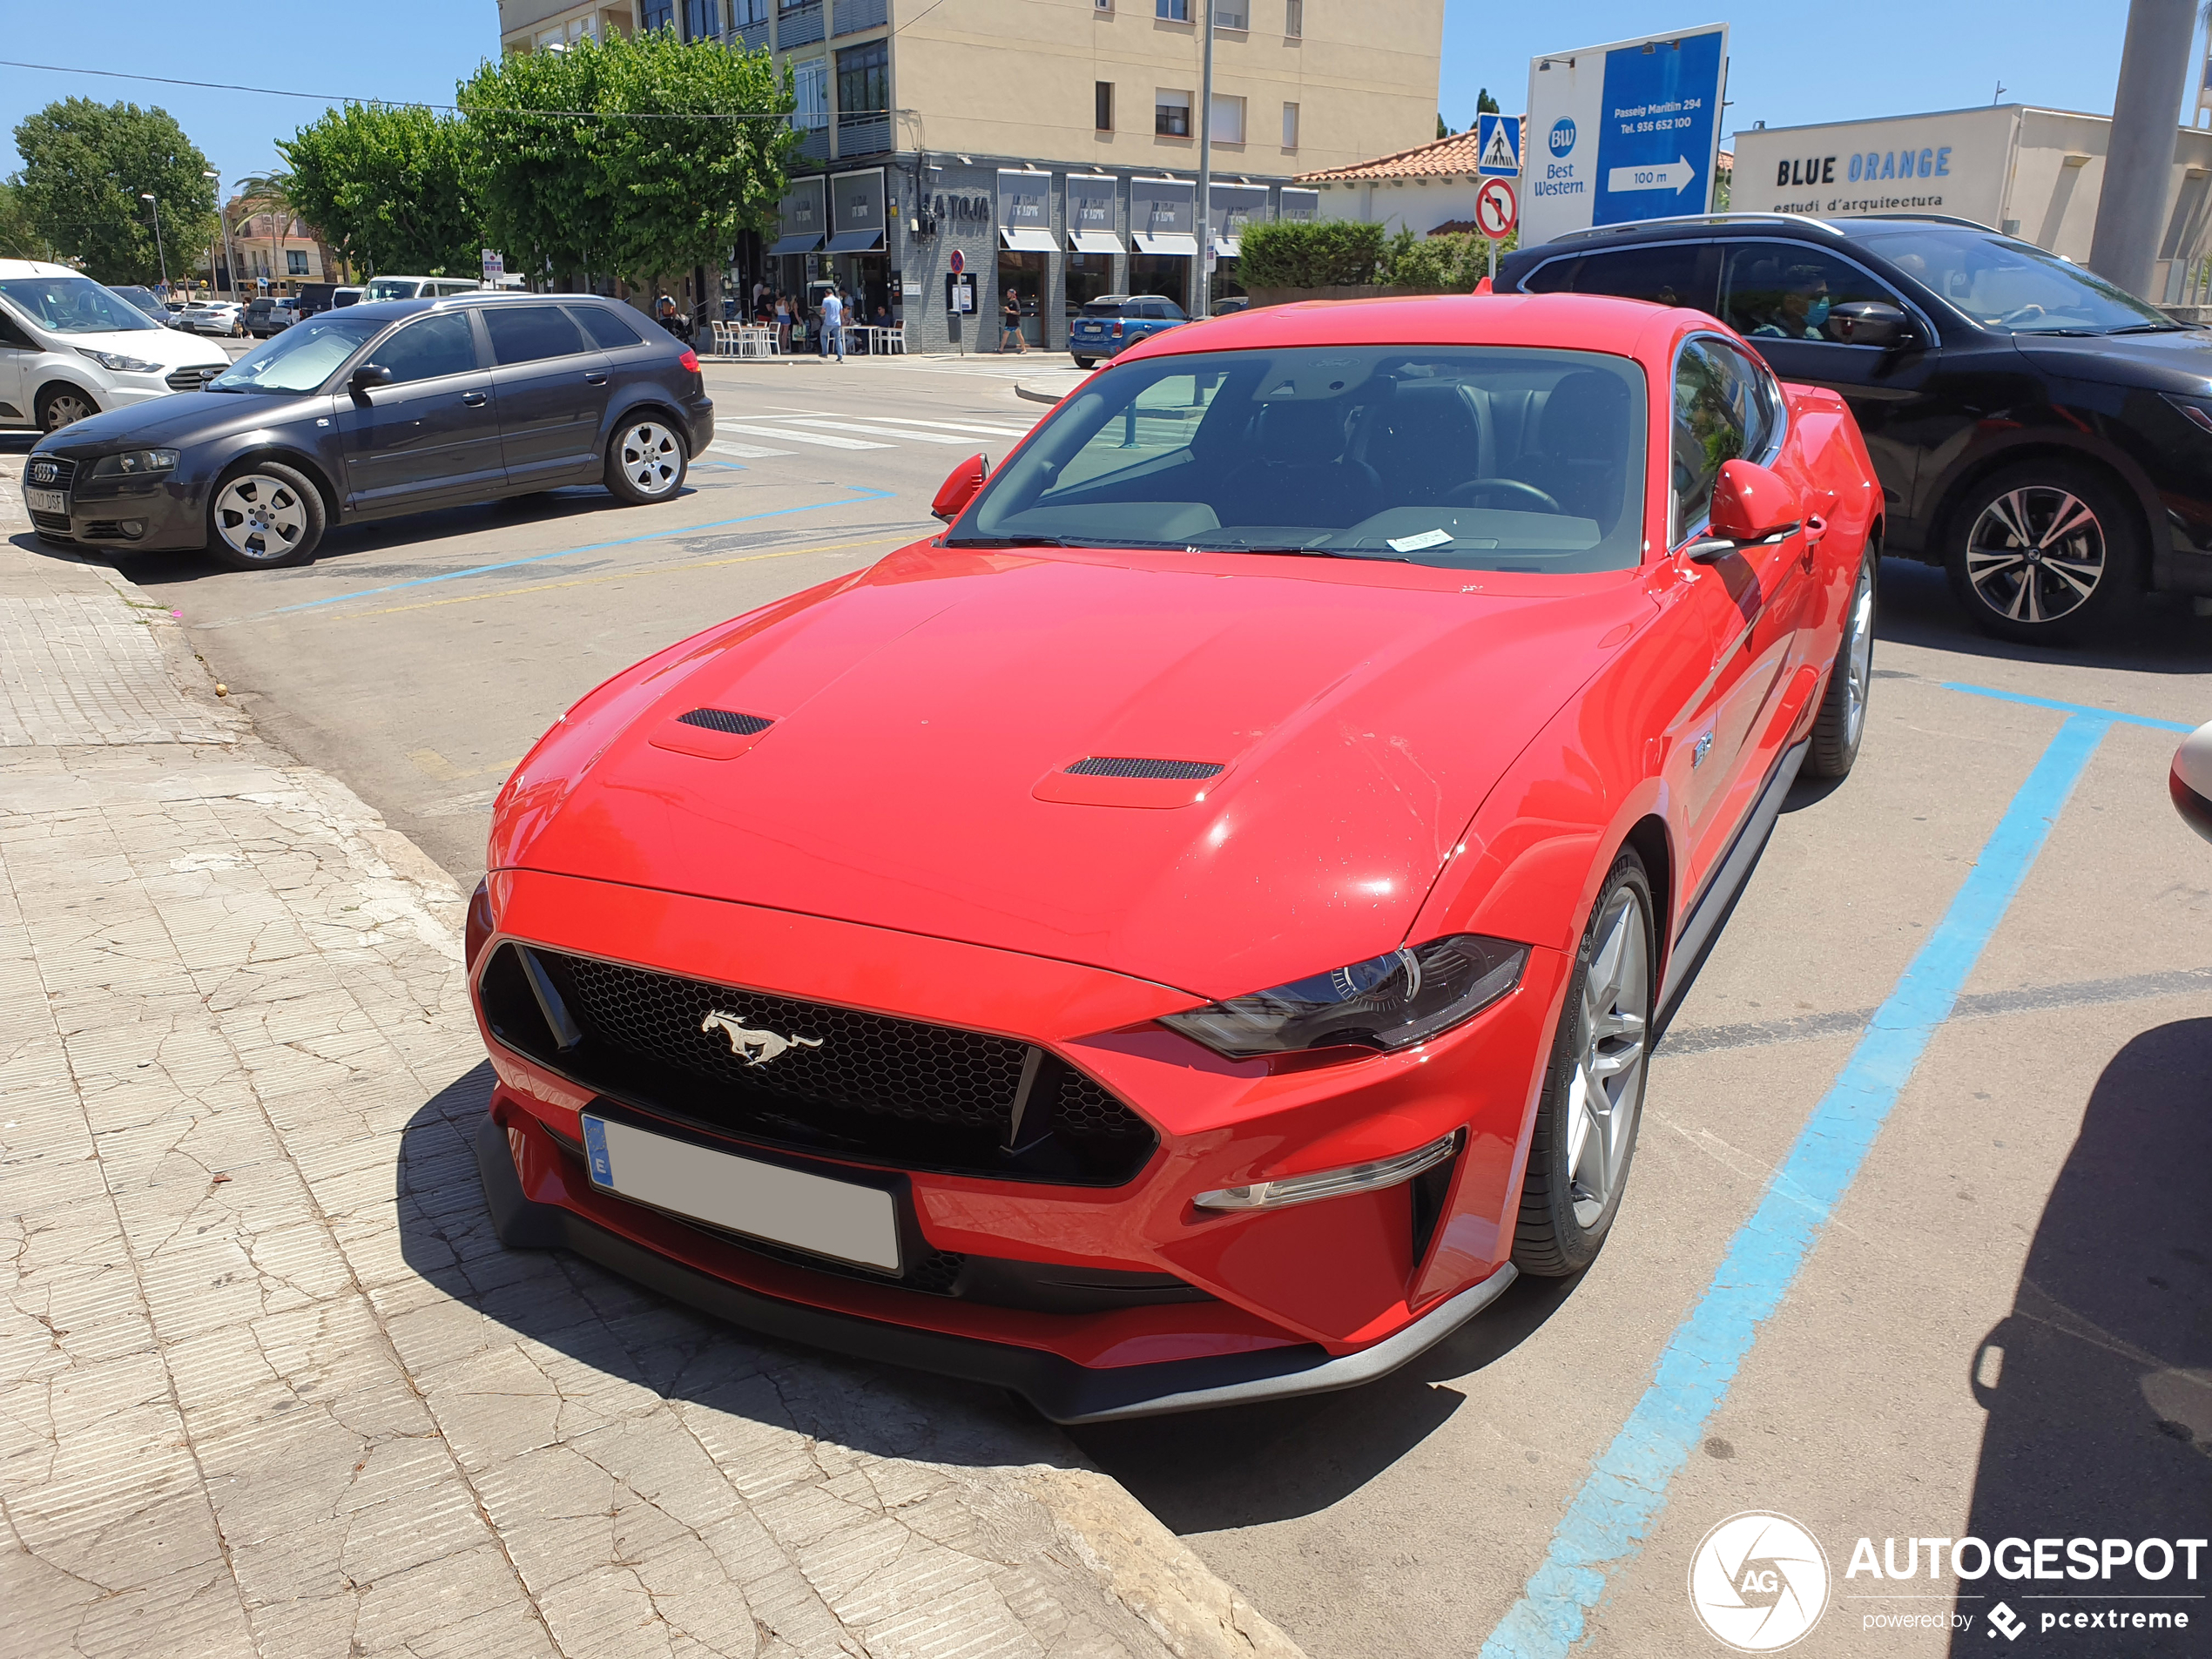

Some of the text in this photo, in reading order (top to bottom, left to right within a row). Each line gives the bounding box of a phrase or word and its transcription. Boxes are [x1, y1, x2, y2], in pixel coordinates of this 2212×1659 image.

[1615, 105, 1646, 118] Passeig
[1683, 98, 1701, 110] 294
[1621, 117, 1691, 134] Tel. 936 652 100
[1551, 129, 1575, 148] BW
[1547, 164, 1575, 179] Best
[1777, 146, 1952, 186] BLUE ORANGE
[1635, 172, 1667, 184] 100 m
[1534, 180, 1584, 197] Western
[948, 195, 989, 220] TOJA
[1774, 196, 1943, 213] estudi d'arquitectura
[596, 1157, 606, 1174] E
